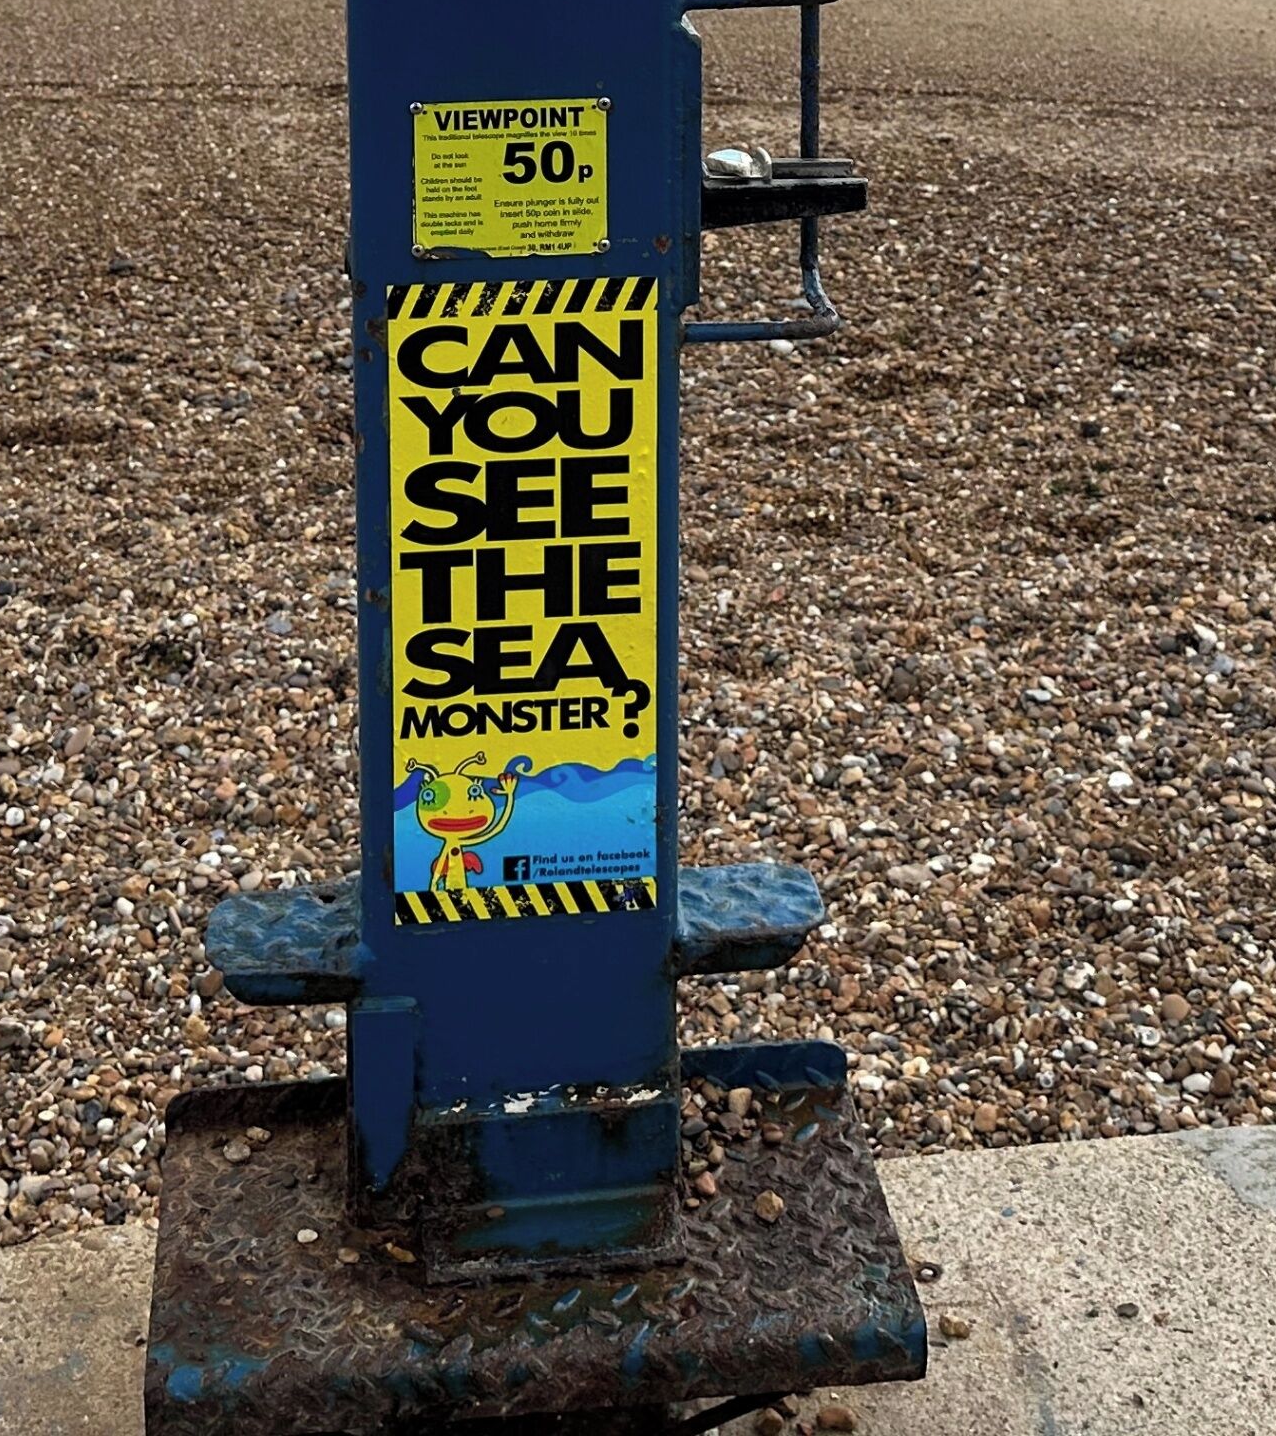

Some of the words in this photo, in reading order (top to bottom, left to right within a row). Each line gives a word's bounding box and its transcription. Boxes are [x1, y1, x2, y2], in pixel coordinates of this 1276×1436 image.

[434, 106, 584, 132] VIEWPOINT
[502, 140, 594, 185] 50p
[420, 177, 448, 185] Children
[494, 199, 523, 208] Ensure
[526, 198, 557, 208] plunger
[558, 197, 566, 205] is
[567, 196, 584, 206] fully
[586, 196, 600, 204] out
[500, 210, 523, 218] insert
[525, 209, 541, 218] 50p
[543, 209, 561, 217] coin
[563, 208, 570, 216] in
[512, 220, 532, 230] push
[534, 220, 558, 228] home
[560, 219, 582, 228] firmly
[520, 231, 536, 239] and
[537, 230, 575, 238] withdraw
[397, 319, 644, 389] CAN
[398, 387, 634, 456] YOU
[400, 455, 630, 546] SEE
[400, 541, 642, 624] THE
[401, 622, 627, 700] SEA
[533, 853, 557, 865] Find
[561, 854, 574, 864] us
[578, 853, 593, 863] on
[597, 849, 651, 862] facebook
[532, 863, 641, 879] /Rolandtelescopes
